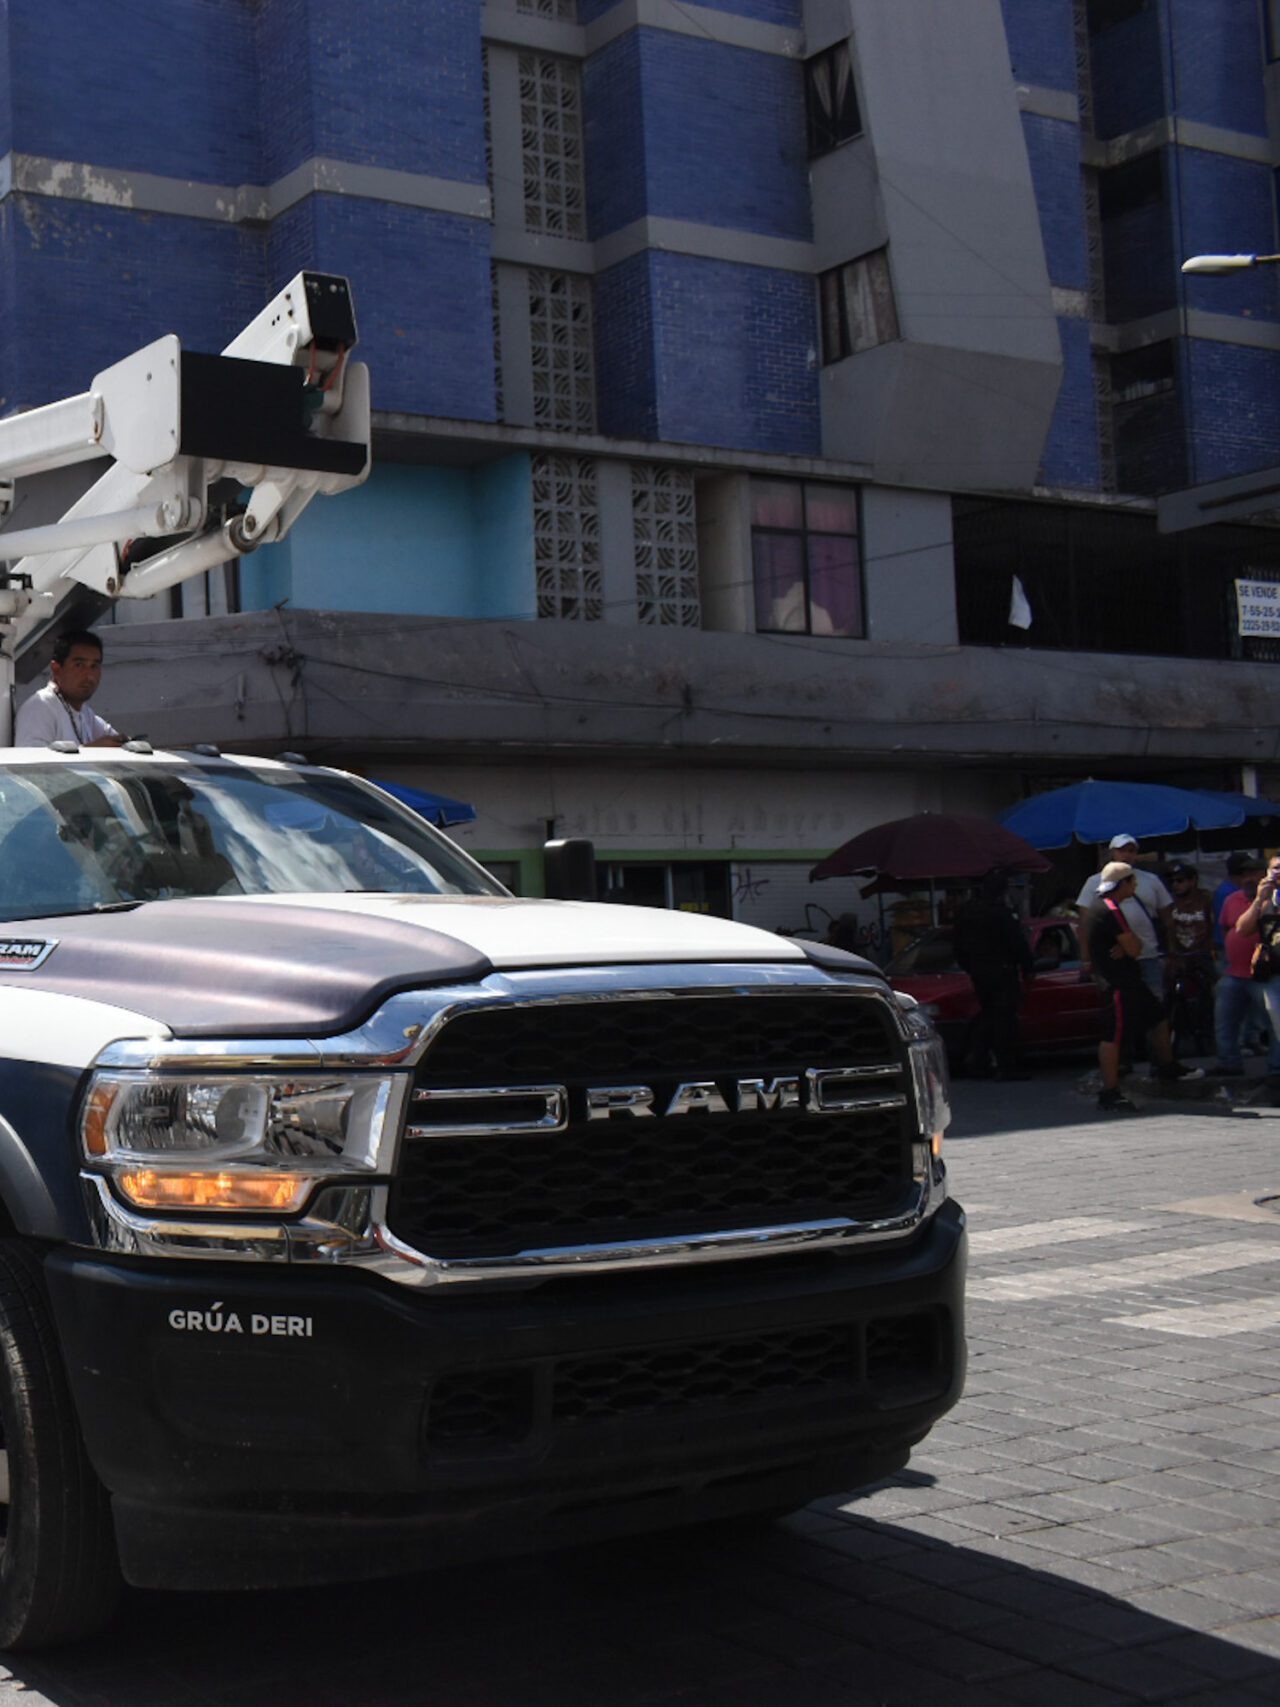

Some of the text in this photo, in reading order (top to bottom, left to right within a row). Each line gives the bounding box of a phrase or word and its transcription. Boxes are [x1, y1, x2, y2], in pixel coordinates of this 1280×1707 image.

[1238, 585, 1250, 597] SE
[586, 1076, 800, 1121] RAM
[168, 1301, 313, 1337] GRÚA DERI
